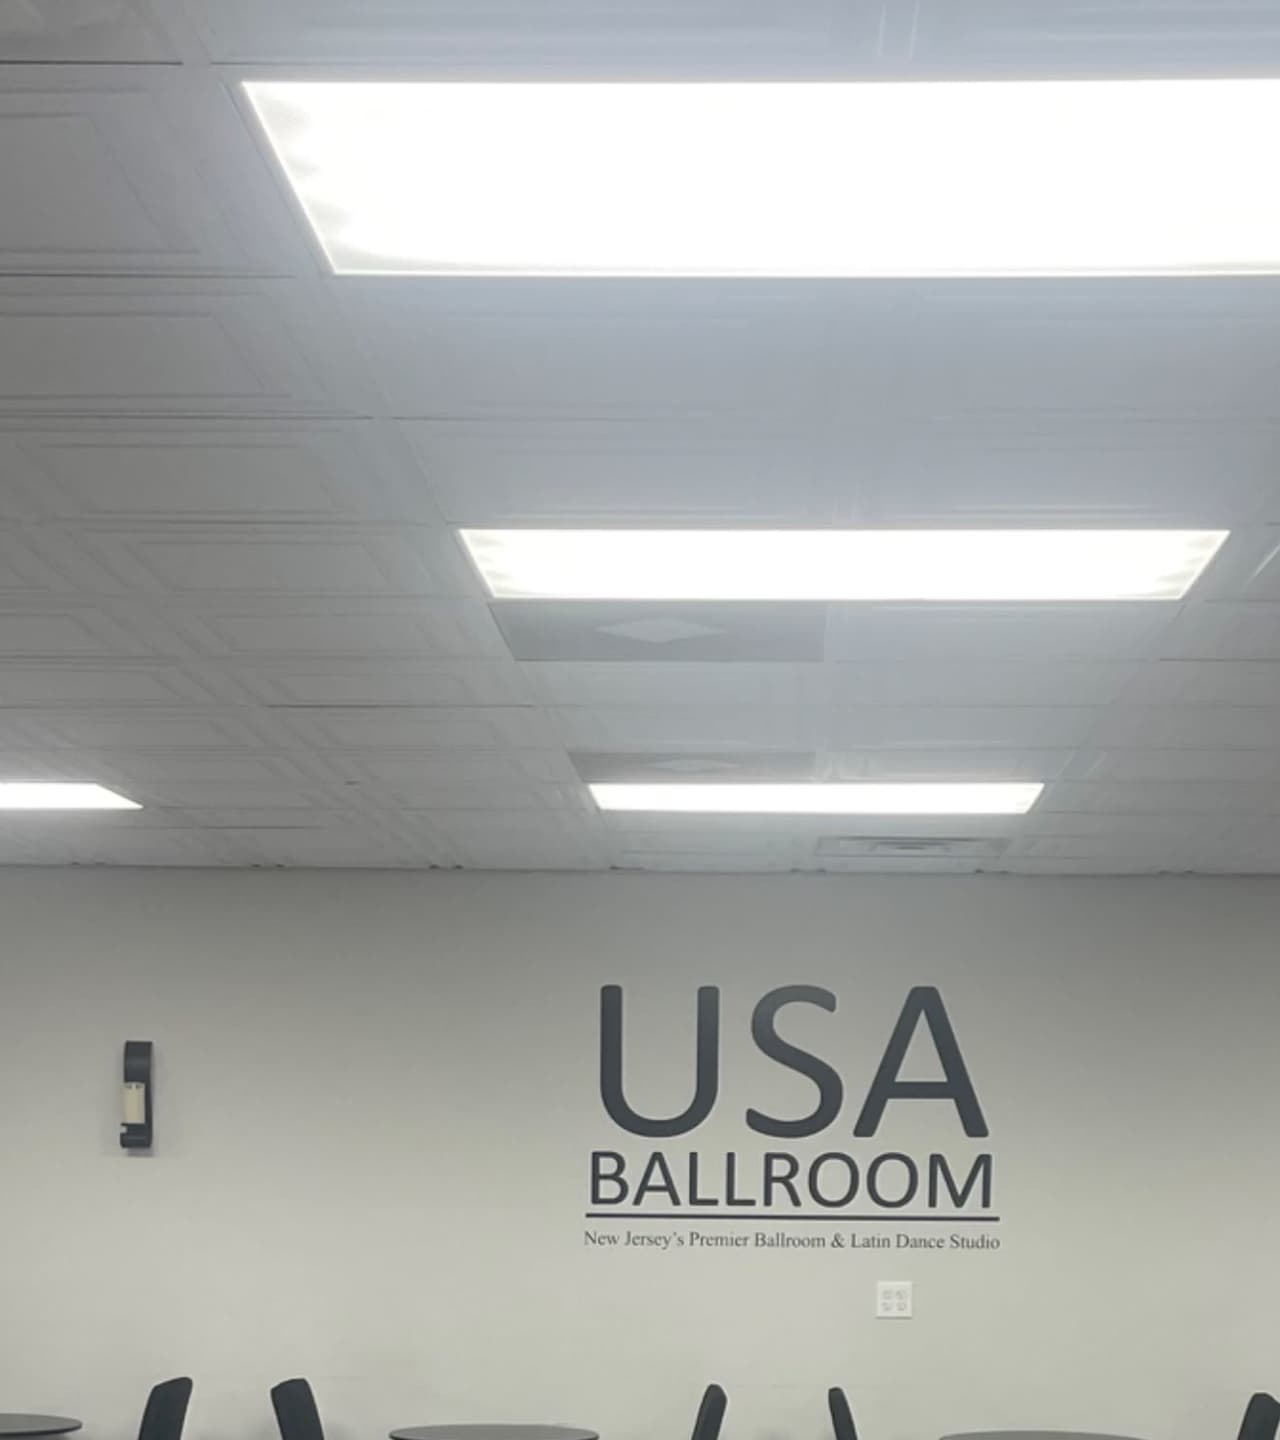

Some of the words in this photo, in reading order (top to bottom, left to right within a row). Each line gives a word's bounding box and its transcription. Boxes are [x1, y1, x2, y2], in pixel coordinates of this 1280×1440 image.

[599, 984, 990, 1139] USA
[590, 1151, 992, 1209] BALLROOM
[584, 1231, 620, 1247] New
[624, 1231, 685, 1250] Jersey's
[689, 1232, 749, 1248] Premier
[754, 1232, 826, 1249] Ballroom
[830, 1232, 845, 1249] &
[851, 1233, 891, 1249] Latin
[895, 1233, 945, 1249] Dance
[950, 1234, 1001, 1250] Studio
